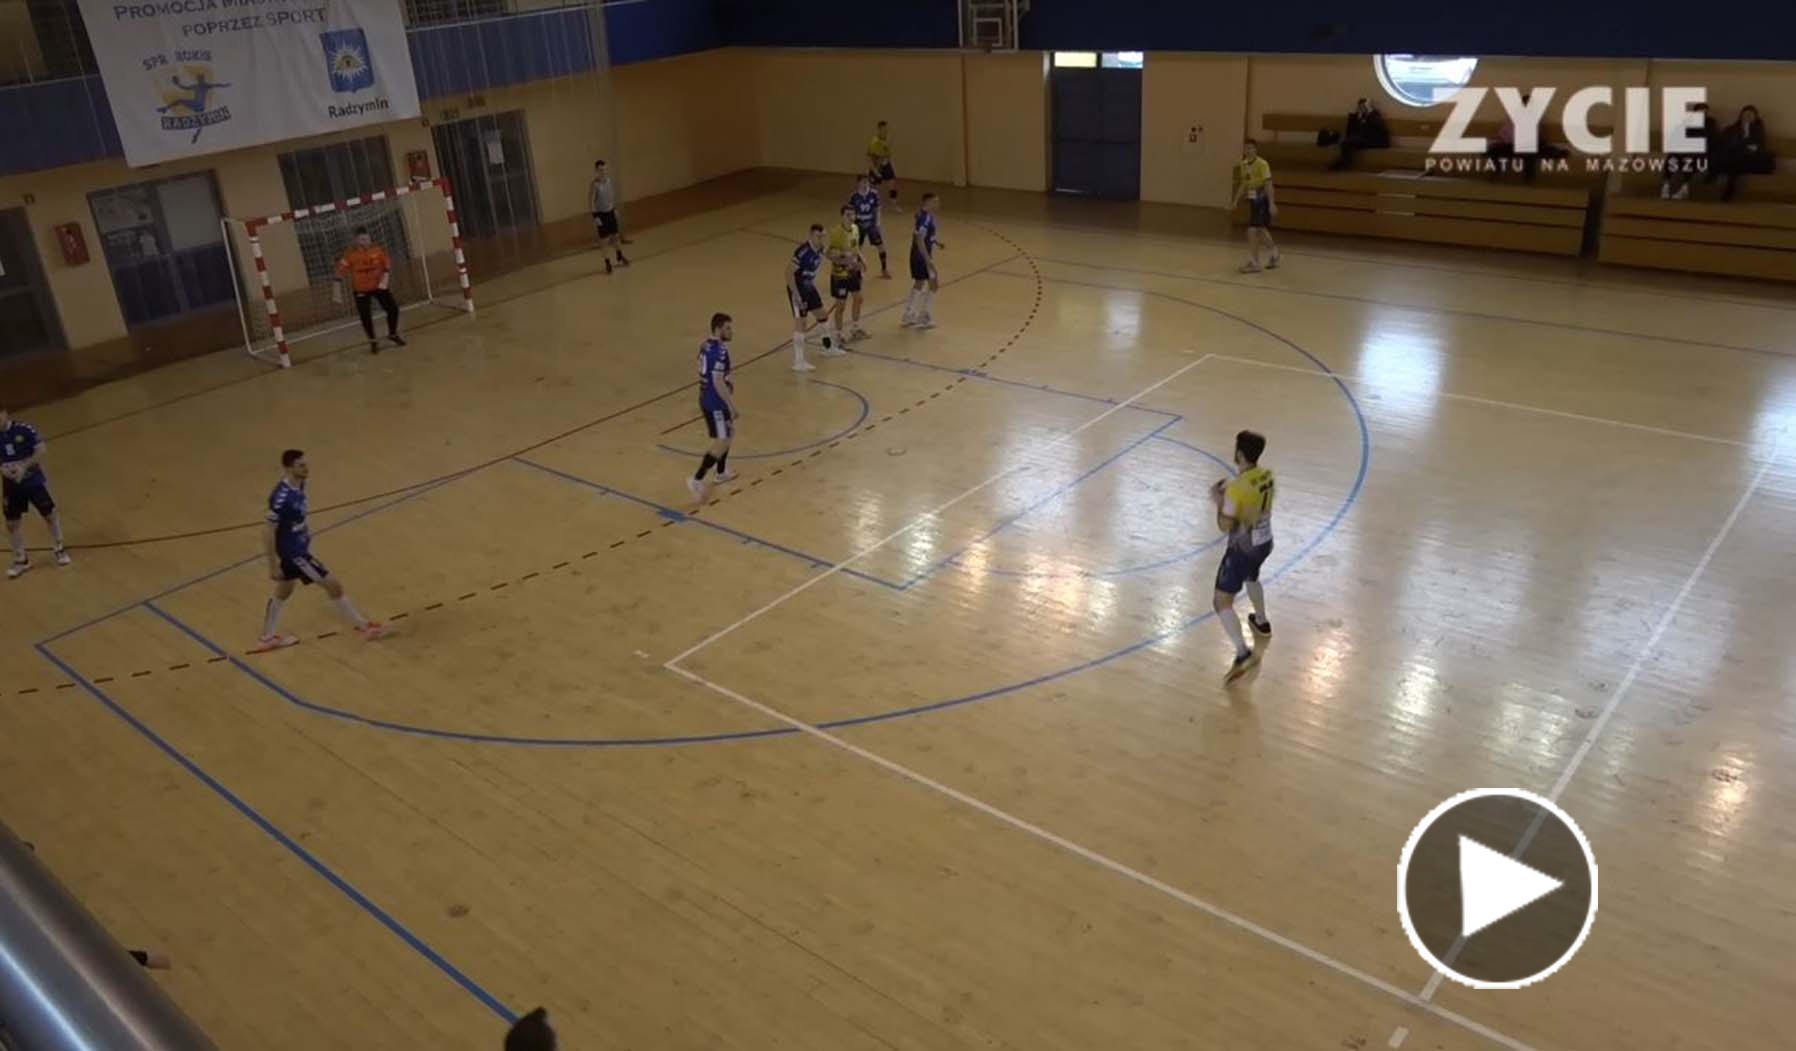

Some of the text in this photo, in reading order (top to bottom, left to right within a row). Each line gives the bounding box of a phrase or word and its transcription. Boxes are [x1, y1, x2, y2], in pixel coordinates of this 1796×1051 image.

[113, 0, 218, 21] PROMOCJA
[182, 8, 327, 37] POPRZEZ SPORT
[328, 97, 389, 118] Radzymin
